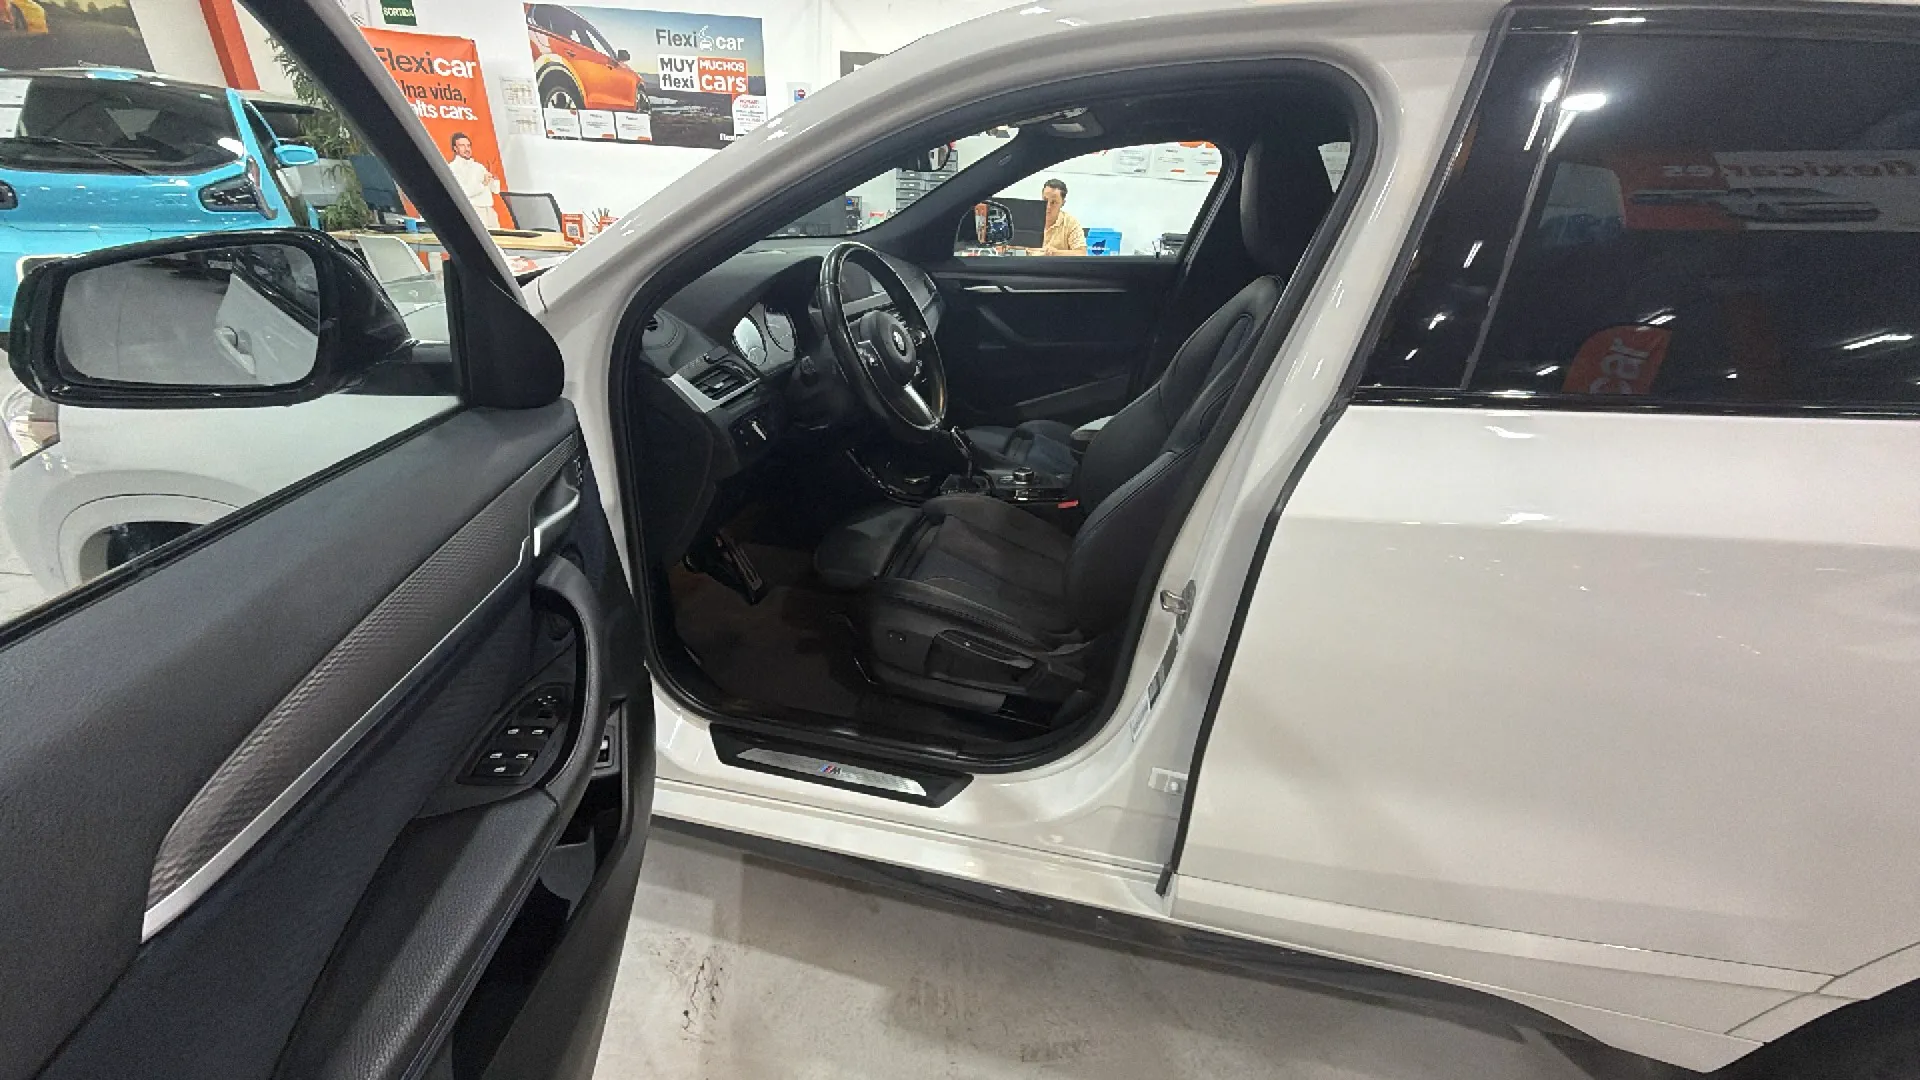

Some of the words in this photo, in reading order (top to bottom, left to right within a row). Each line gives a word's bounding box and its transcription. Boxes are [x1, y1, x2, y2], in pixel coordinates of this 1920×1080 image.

[383, 7, 414, 17] SORTIDA
[655, 28, 698, 48] Flexi
[716, 36, 745, 51] car
[659, 57, 696, 73] MUY
[699, 59, 746, 73] MUCHOS
[661, 73, 695, 89] flexi
[701, 74, 747, 93] cars
[429, 82, 467, 104] vida,
[439, 104, 479, 121] cars.
